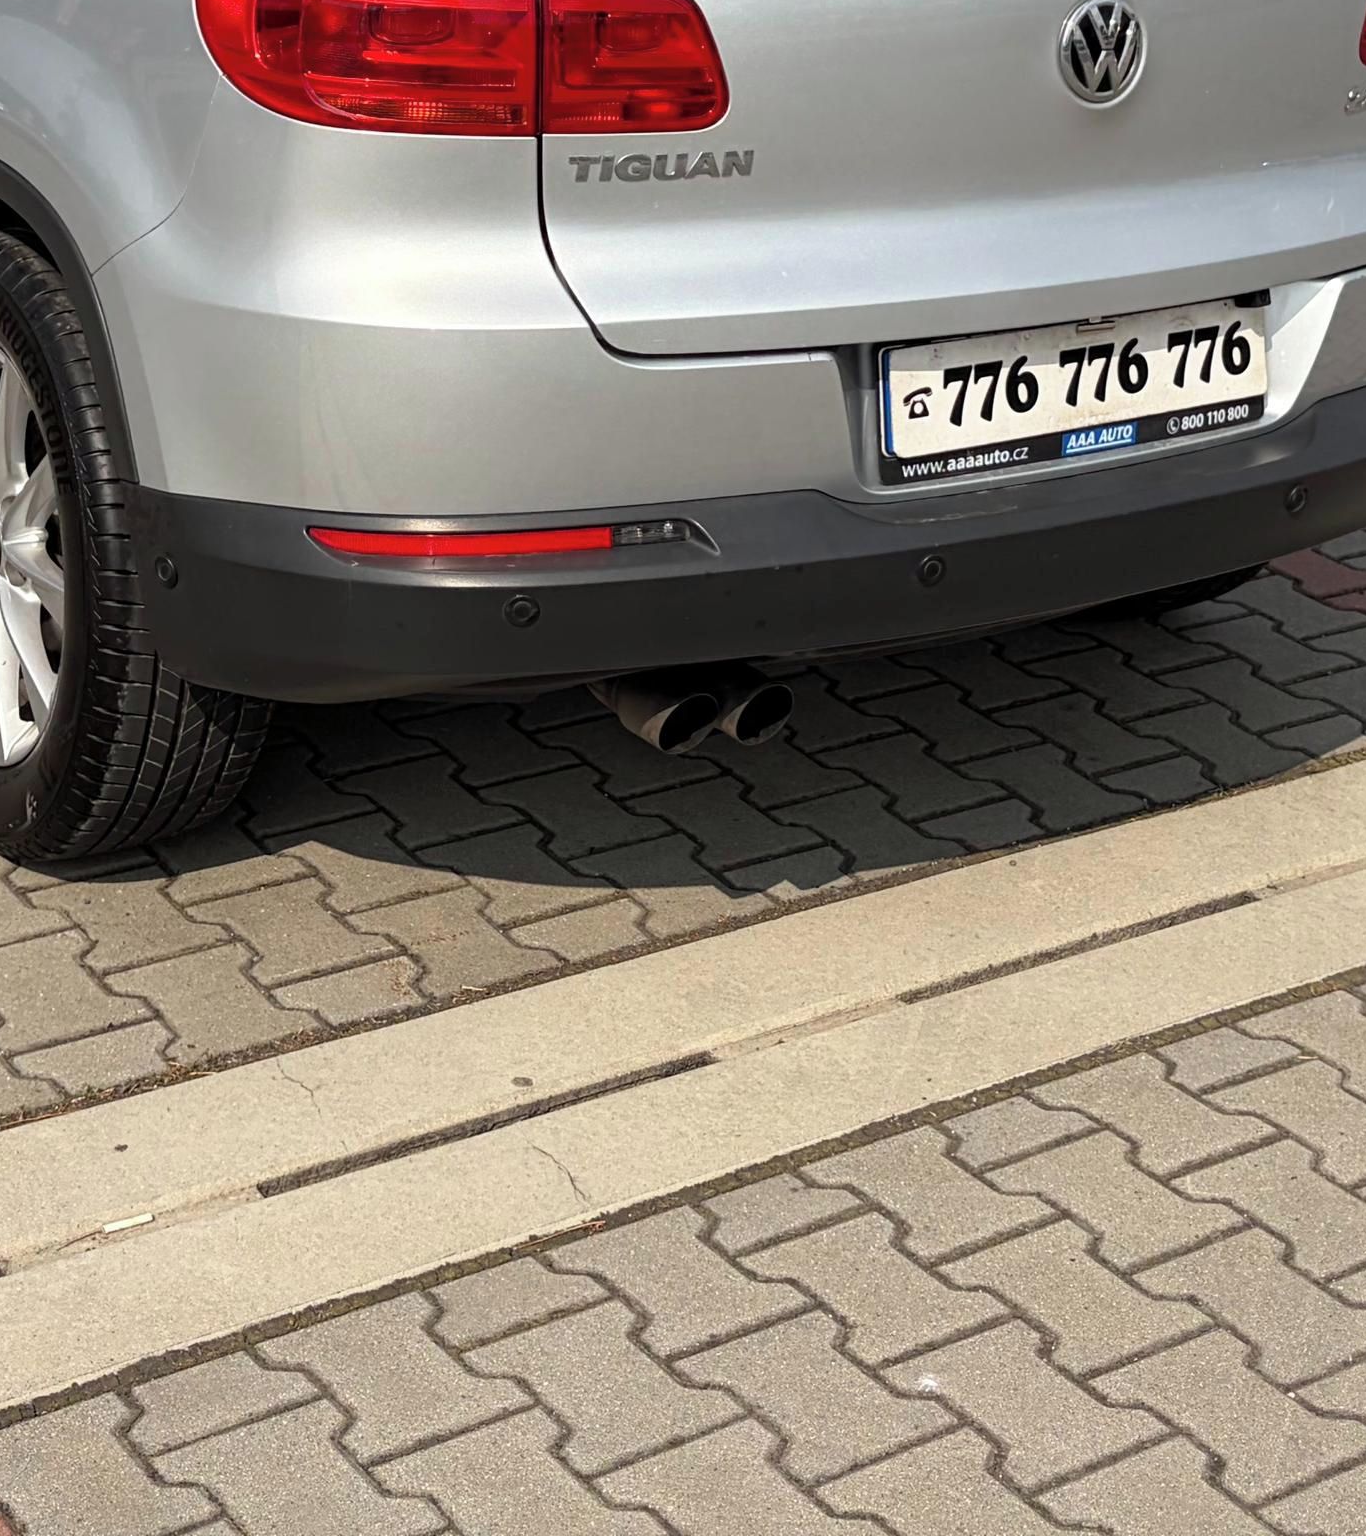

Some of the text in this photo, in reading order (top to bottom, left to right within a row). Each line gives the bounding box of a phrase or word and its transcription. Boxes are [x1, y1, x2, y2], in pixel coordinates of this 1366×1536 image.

[568, 150, 754, 182] TIGUAN
[943, 320, 1251, 427] 776 776 776
[1181, 404, 1249, 431] 800 110 800
[1066, 425, 1133, 449] AAA AUTO
[902, 447, 1029, 478] www.aaaauto.cz
